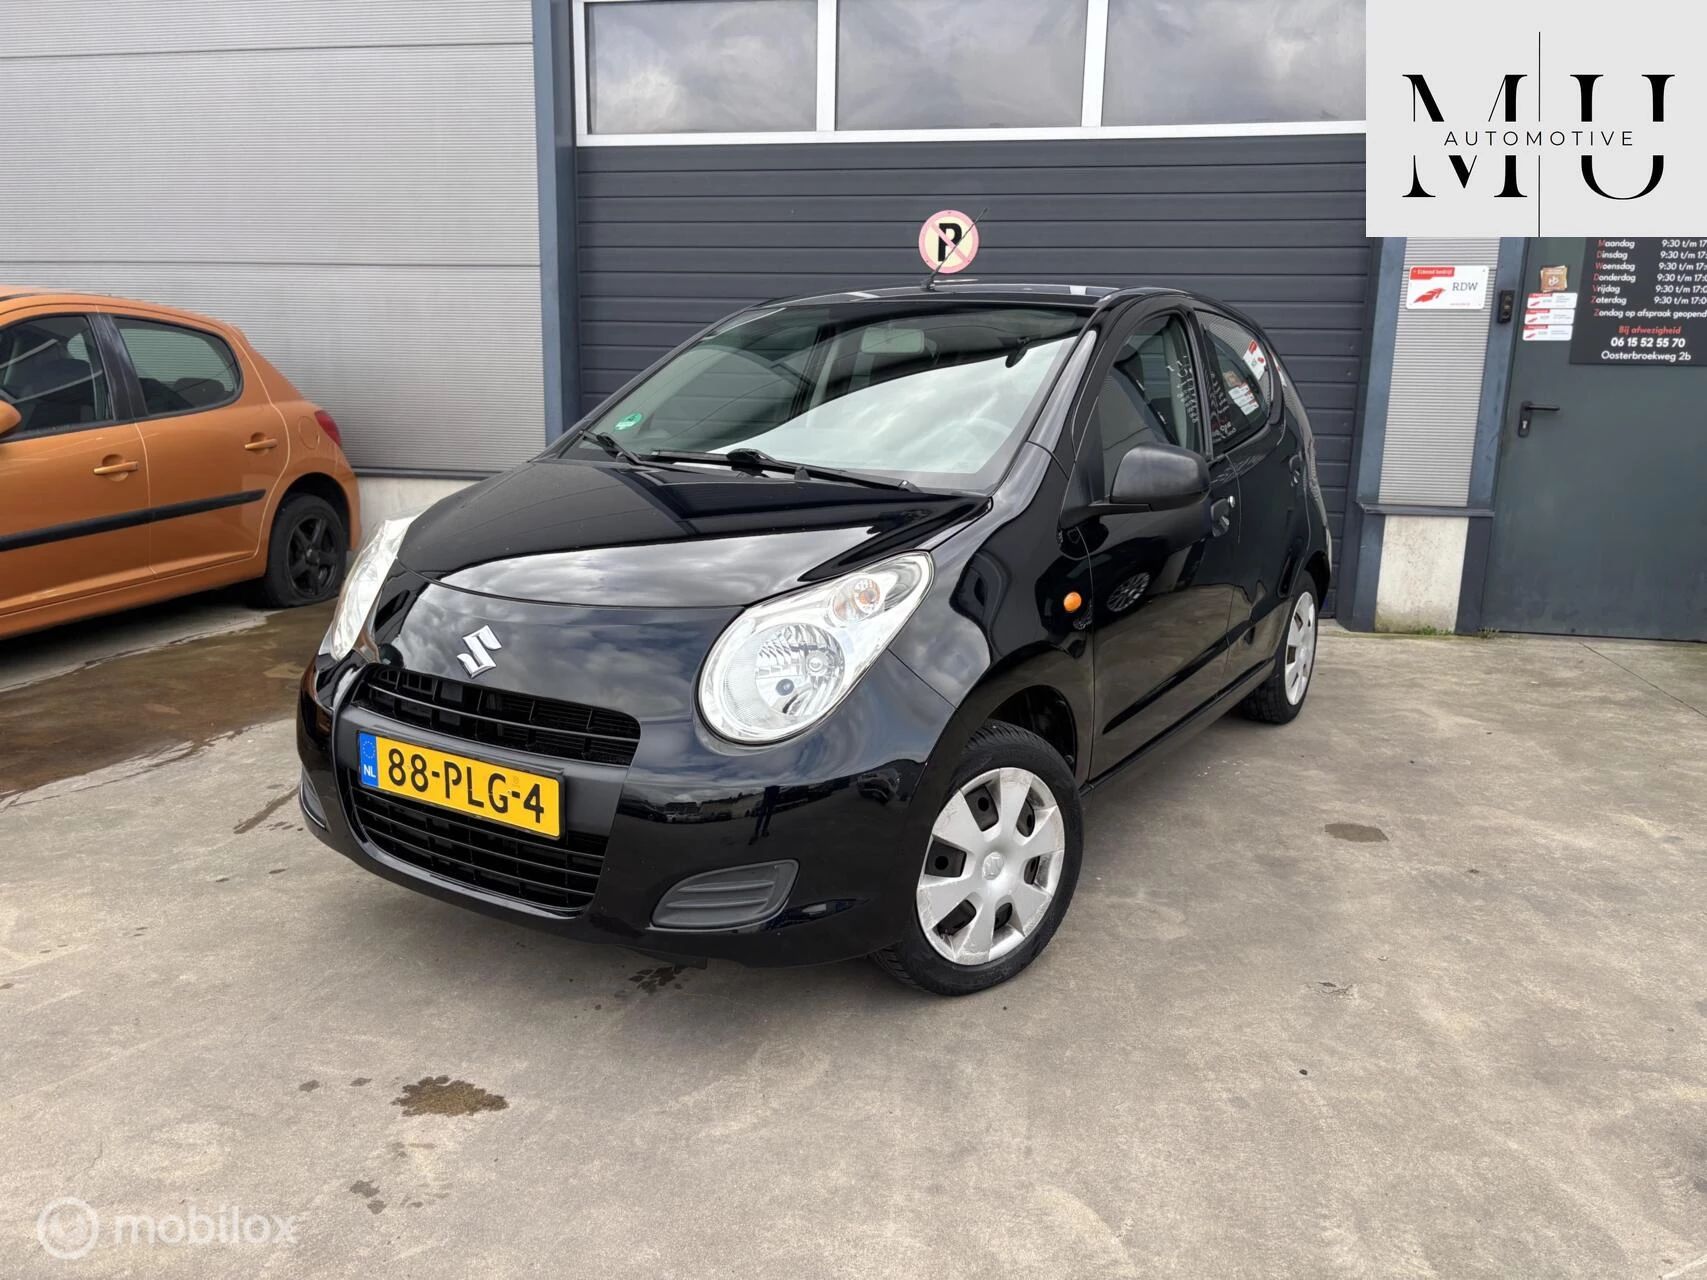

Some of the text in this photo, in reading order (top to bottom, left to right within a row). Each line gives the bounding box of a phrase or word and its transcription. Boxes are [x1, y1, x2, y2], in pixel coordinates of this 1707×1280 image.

[938, 222, 962, 262] P
[1598, 239, 1635, 249] Maandag
[1662, 239, 1680, 247] 9:30
[1682, 239, 1697, 248] t/m
[1596, 250, 1628, 260] Dinsdag
[1660, 250, 1678, 259] 9:30
[1680, 250, 1695, 259] t/m
[1594, 262, 1635, 271] Woensdag
[1658, 262, 1677, 270] 9:30
[1679, 262, 1694, 271] t/m
[1593, 273, 1636, 283] Donderdag
[1656, 273, 1675, 281] 9:30
[1677, 273, 1692, 282] t/m
[1452, 282, 1478, 291] RDW
[1592, 284, 1620, 294] Vrijdag
[1655, 284, 1674, 293] 9:30
[1675, 285, 1690, 293] t/m
[1591, 296, 1627, 306] Zaterdag
[1653, 296, 1672, 304] 9:30
[1674, 296, 1689, 304] t/m
[1593, 308, 1623, 318] Zondag
[1637, 308, 1671, 318] afspraak
[1672, 309, 1707, 319] geopend
[1618, 325, 1682, 335] Bij afwezigheid
[1610, 336, 1686, 348] 06 15 52 55 70
[1601, 350, 1692, 362] Oosterbroekweg 2b
[363, 764, 377, 778] NL
[388, 748, 545, 824] 88-PLG-4
